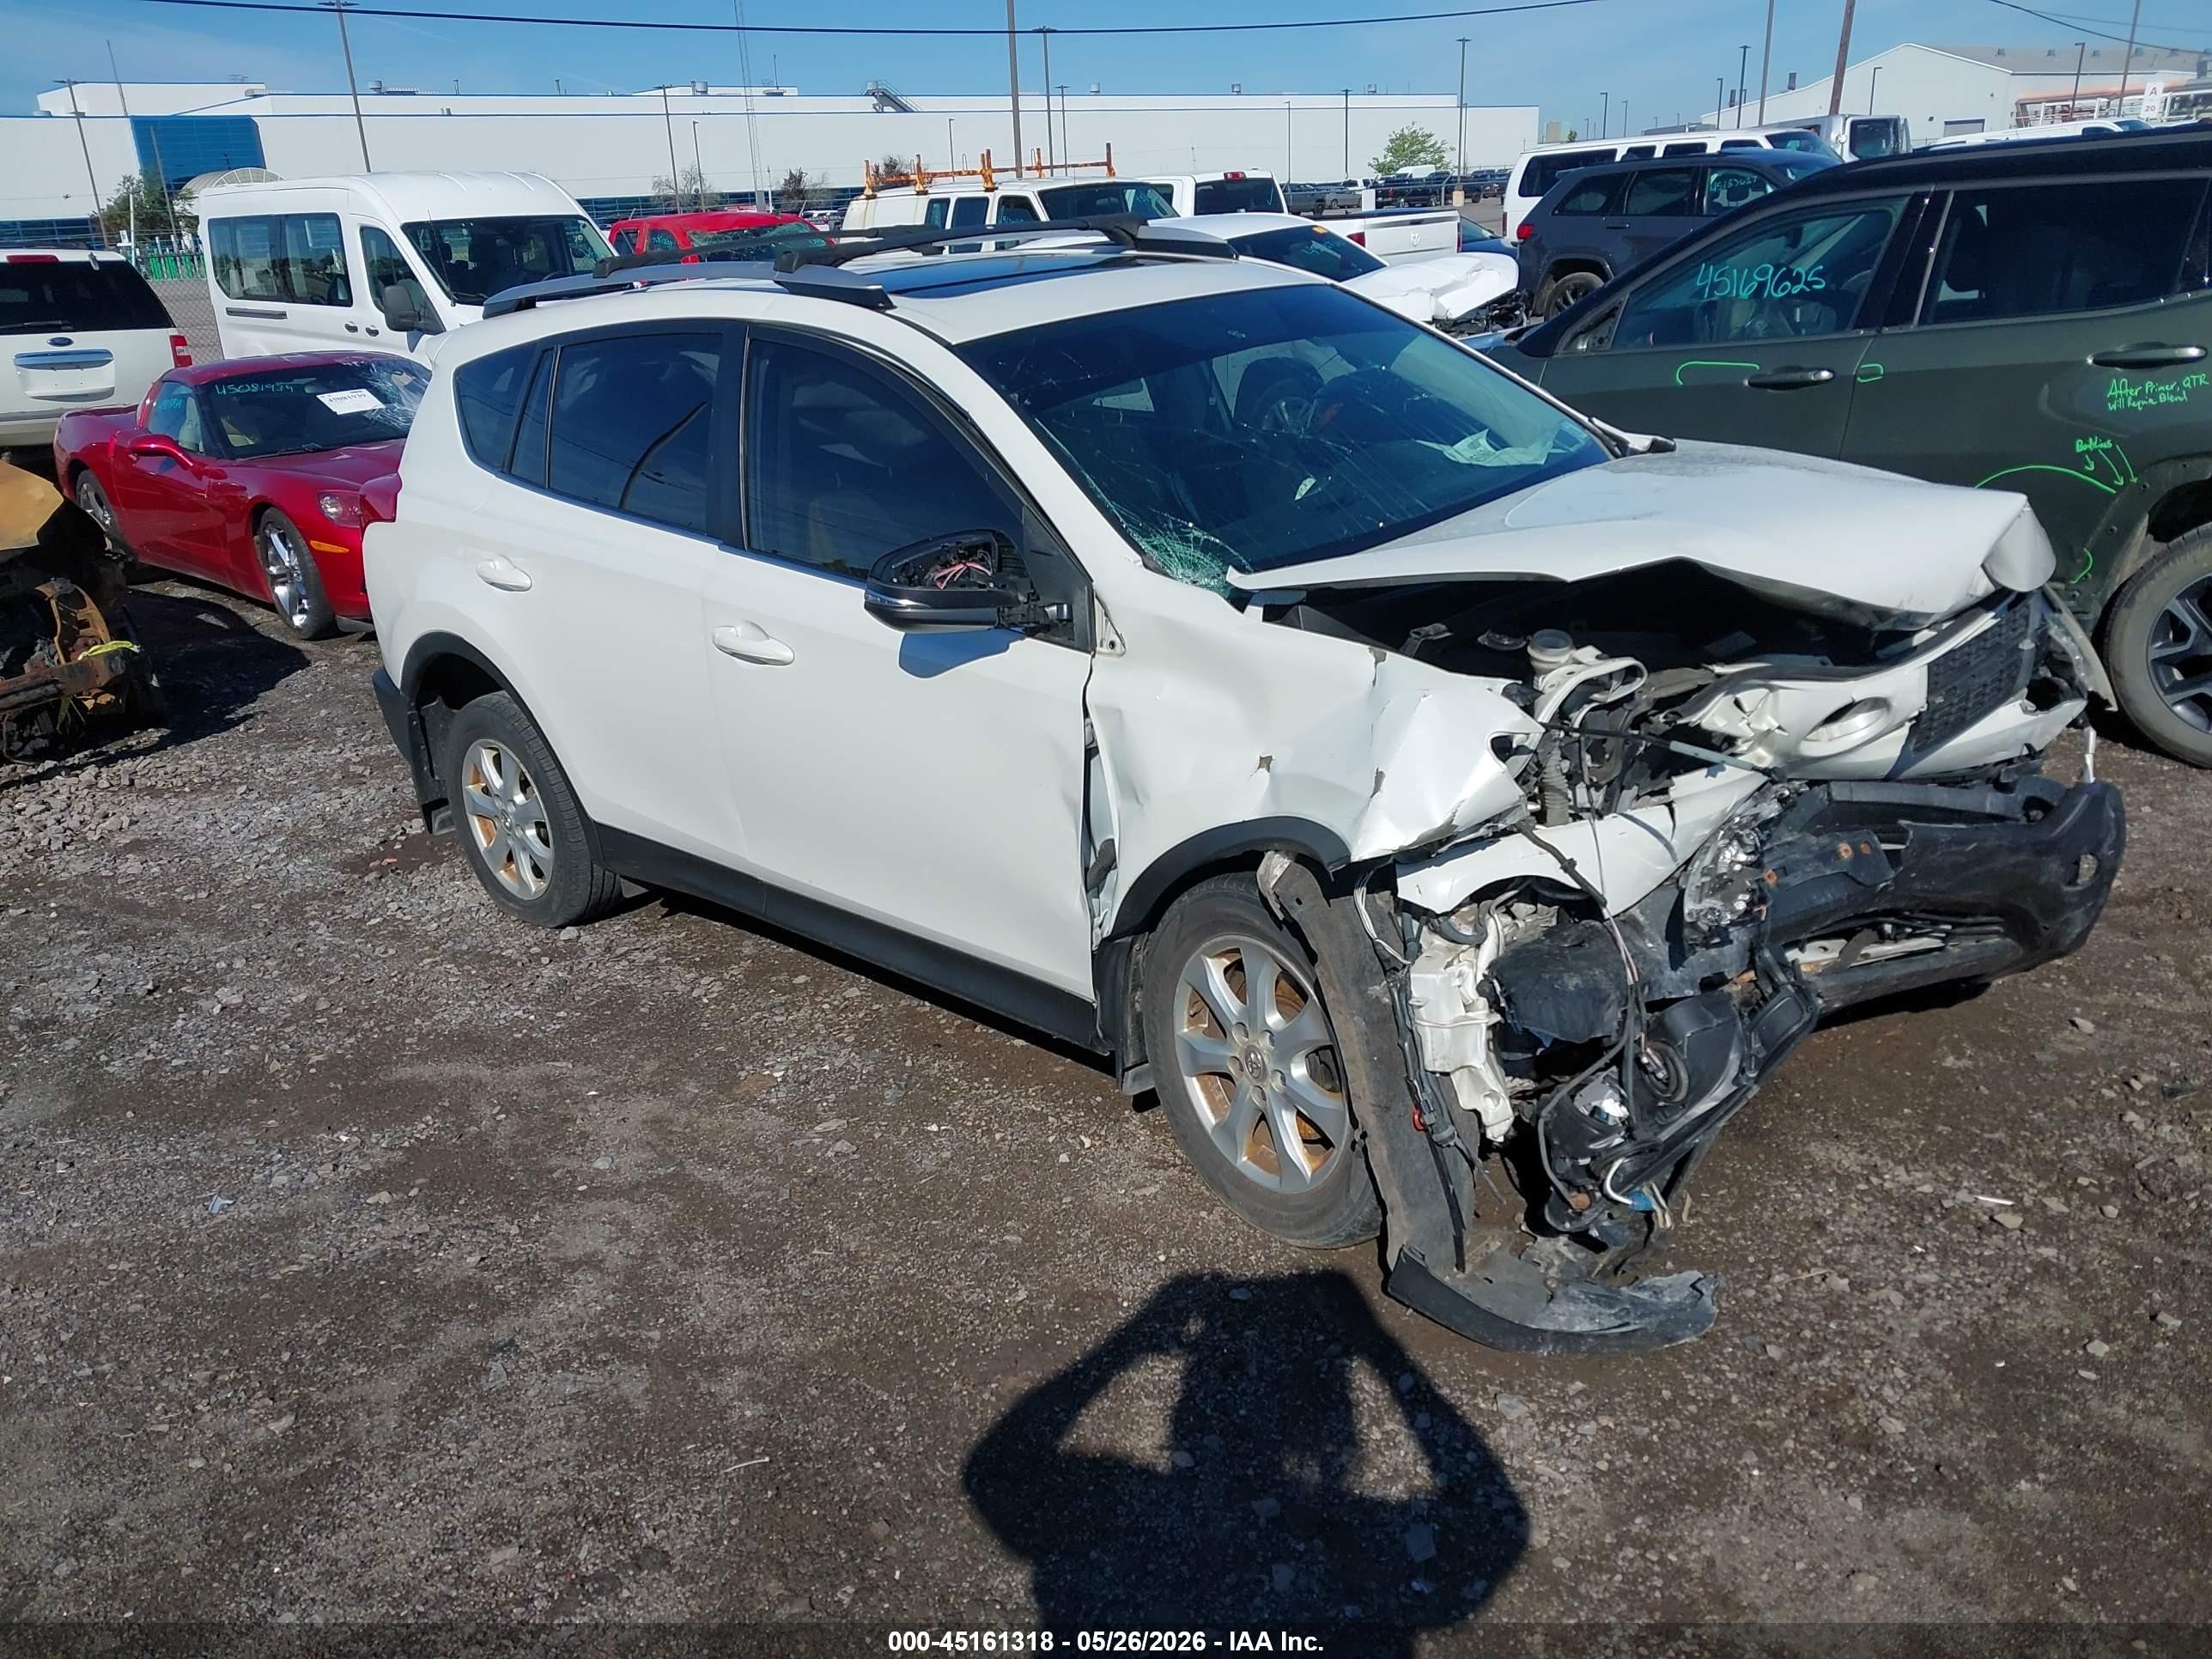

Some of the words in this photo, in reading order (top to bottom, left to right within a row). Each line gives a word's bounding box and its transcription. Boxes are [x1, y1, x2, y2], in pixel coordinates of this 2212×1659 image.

[2148, 87, 2157, 96] A
[1696, 263, 1826, 299] 45169625
[214, 383, 294, 395] 45081939
[2107, 378, 2142, 398] After
[2183, 374, 2209, 389] QTR
[2160, 391, 2189, 403] Blend
